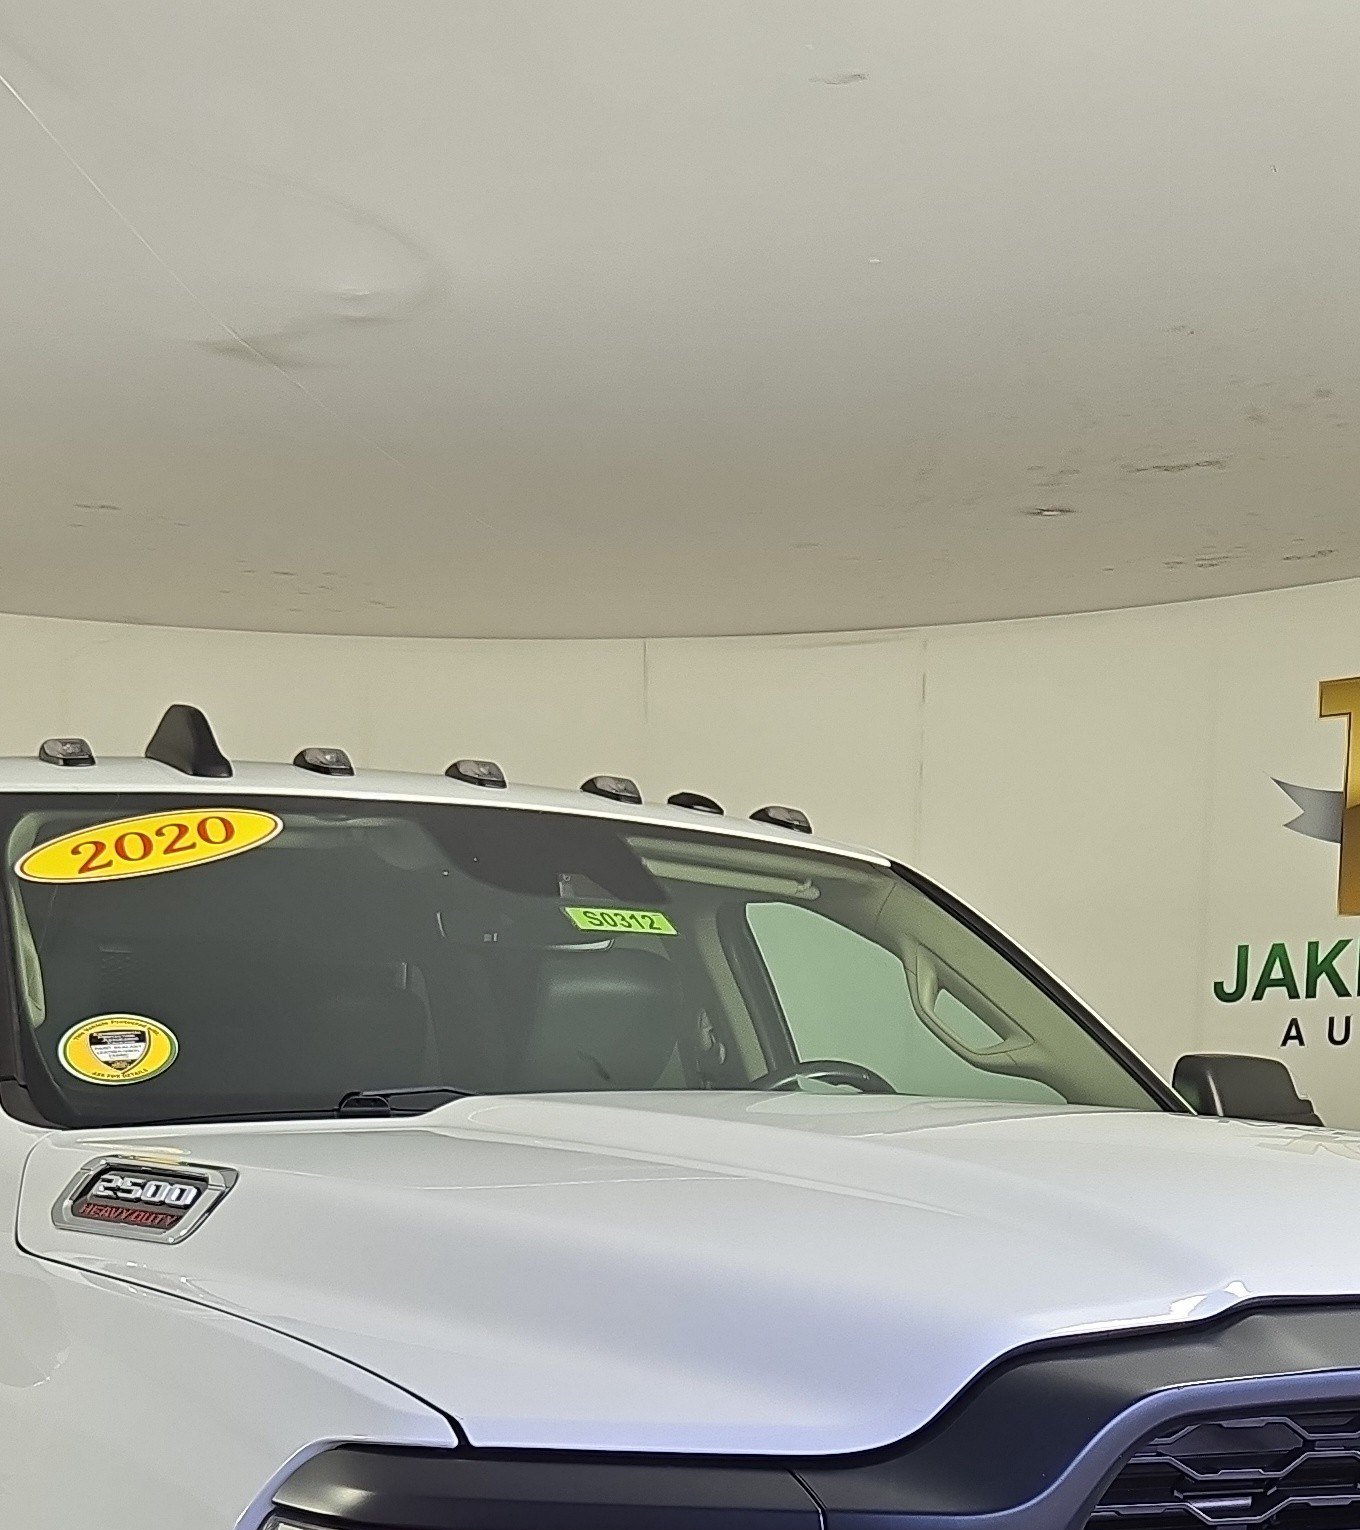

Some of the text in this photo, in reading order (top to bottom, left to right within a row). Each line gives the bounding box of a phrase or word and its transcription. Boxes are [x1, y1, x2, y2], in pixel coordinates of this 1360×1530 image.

[70, 816, 236, 875] 2020
[582, 910, 663, 931] S0312
[91, 1173, 199, 1206] 2500
[78, 1203, 180, 1227] HEAVY DUTY
